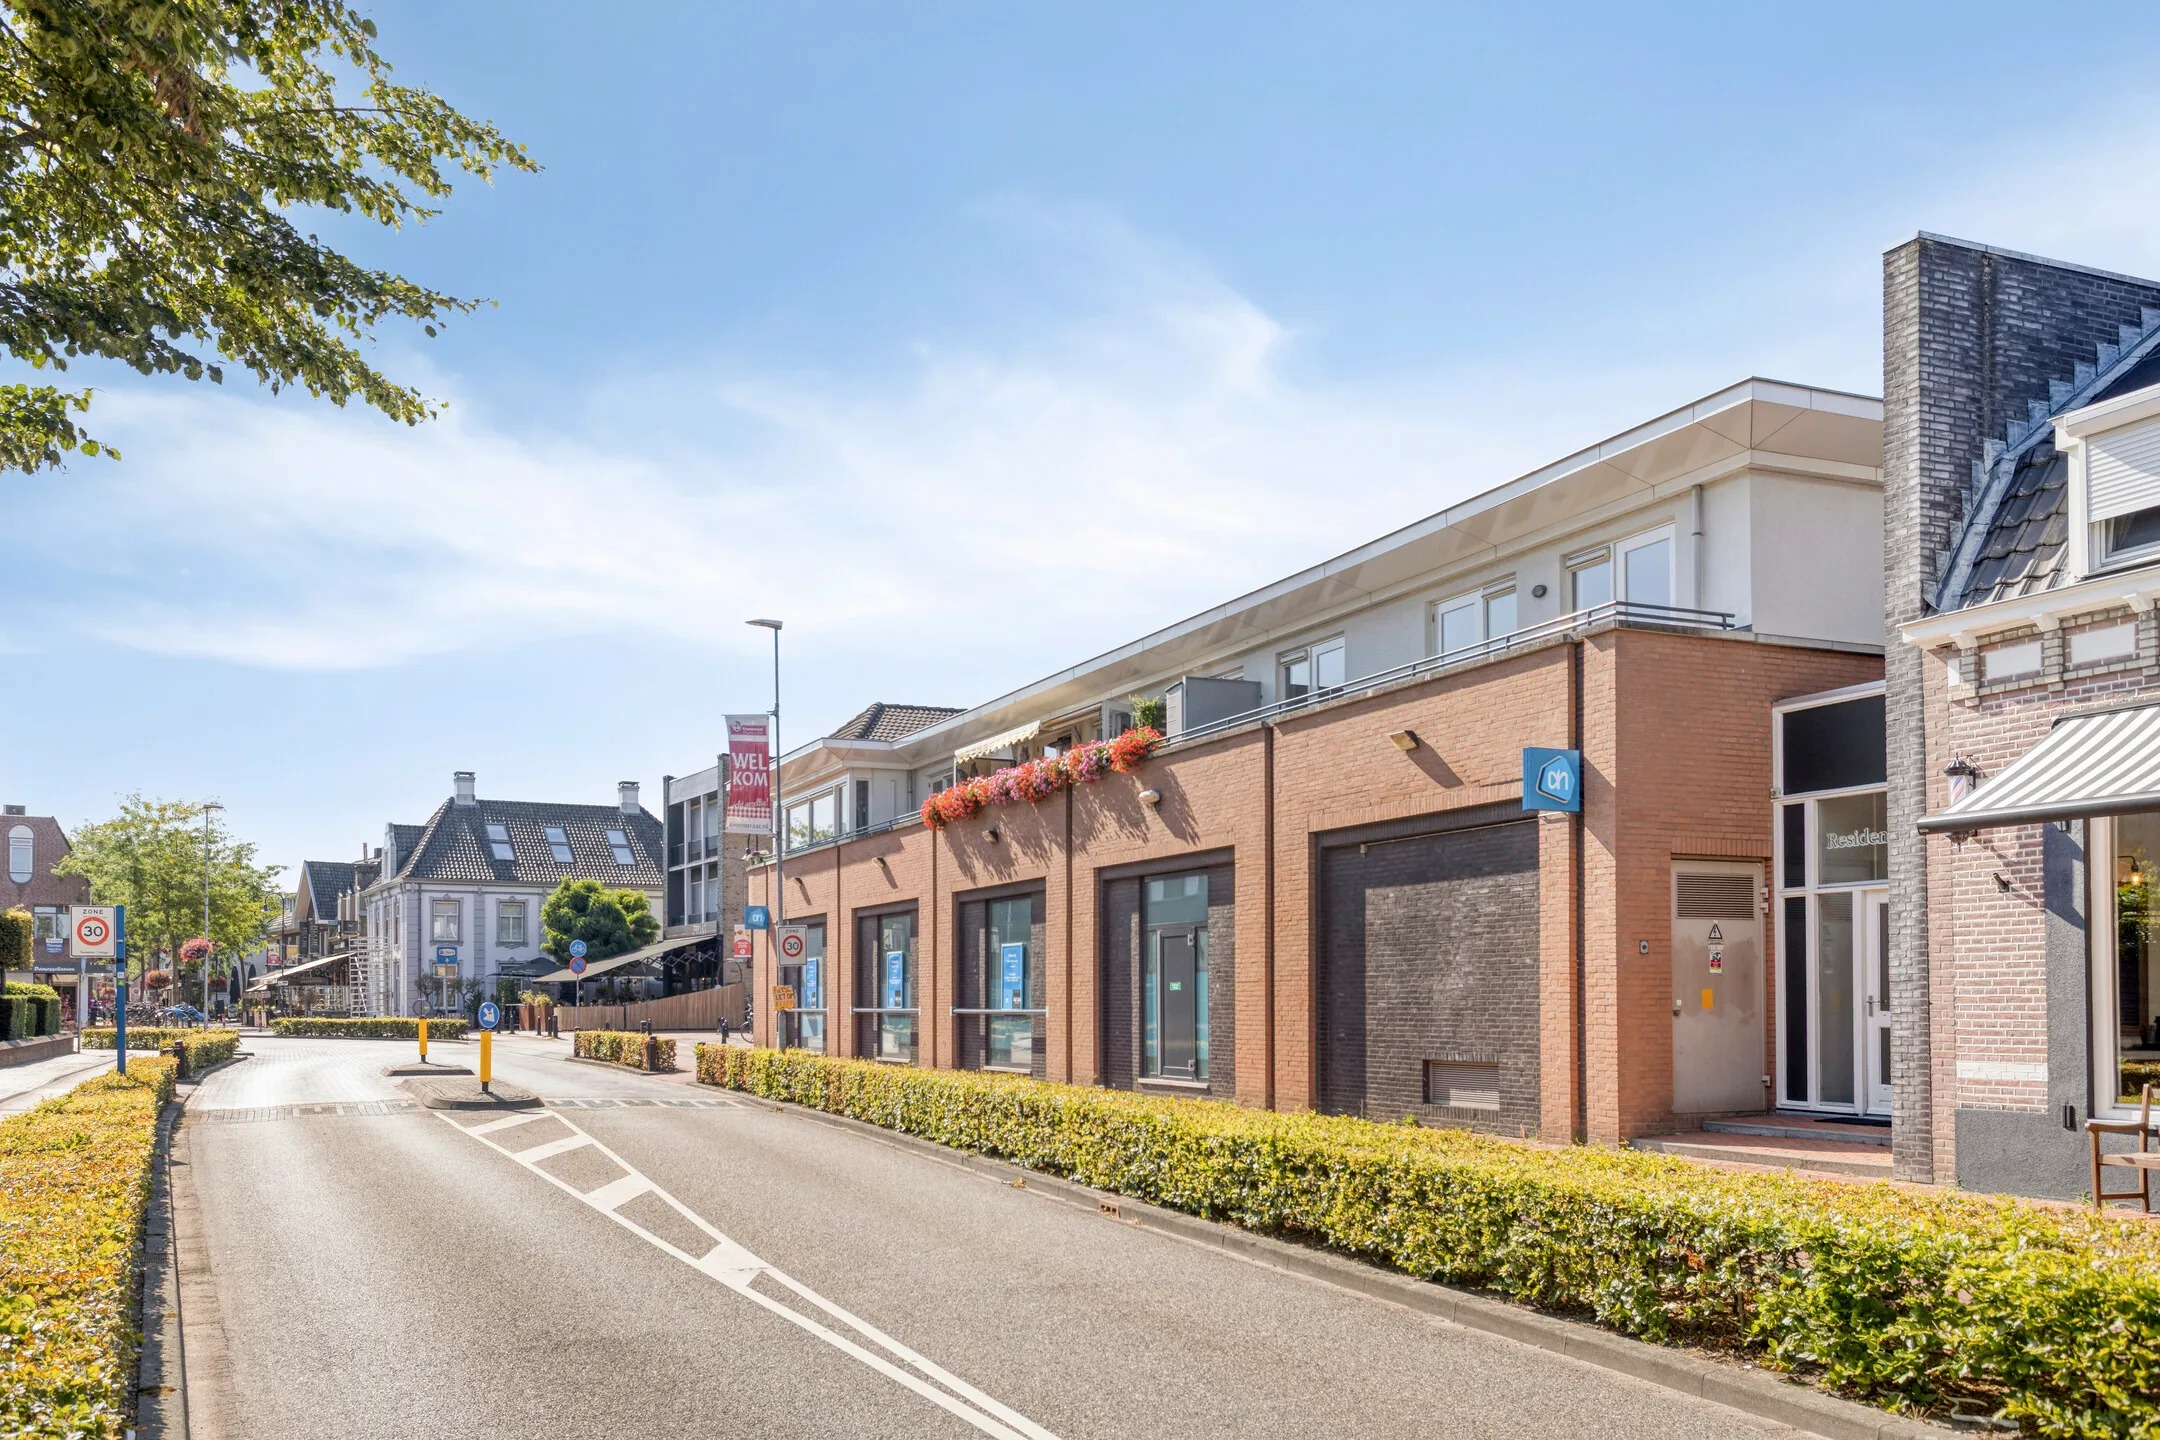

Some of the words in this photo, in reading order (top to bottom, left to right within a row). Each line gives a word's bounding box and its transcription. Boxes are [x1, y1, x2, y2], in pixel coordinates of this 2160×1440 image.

[731, 752, 768, 771] WEL
[733, 771, 768, 787] KOM
[1826, 827, 1889, 849] Residen
[84, 926, 103, 937] 30
[787, 942, 799, 950] 30
